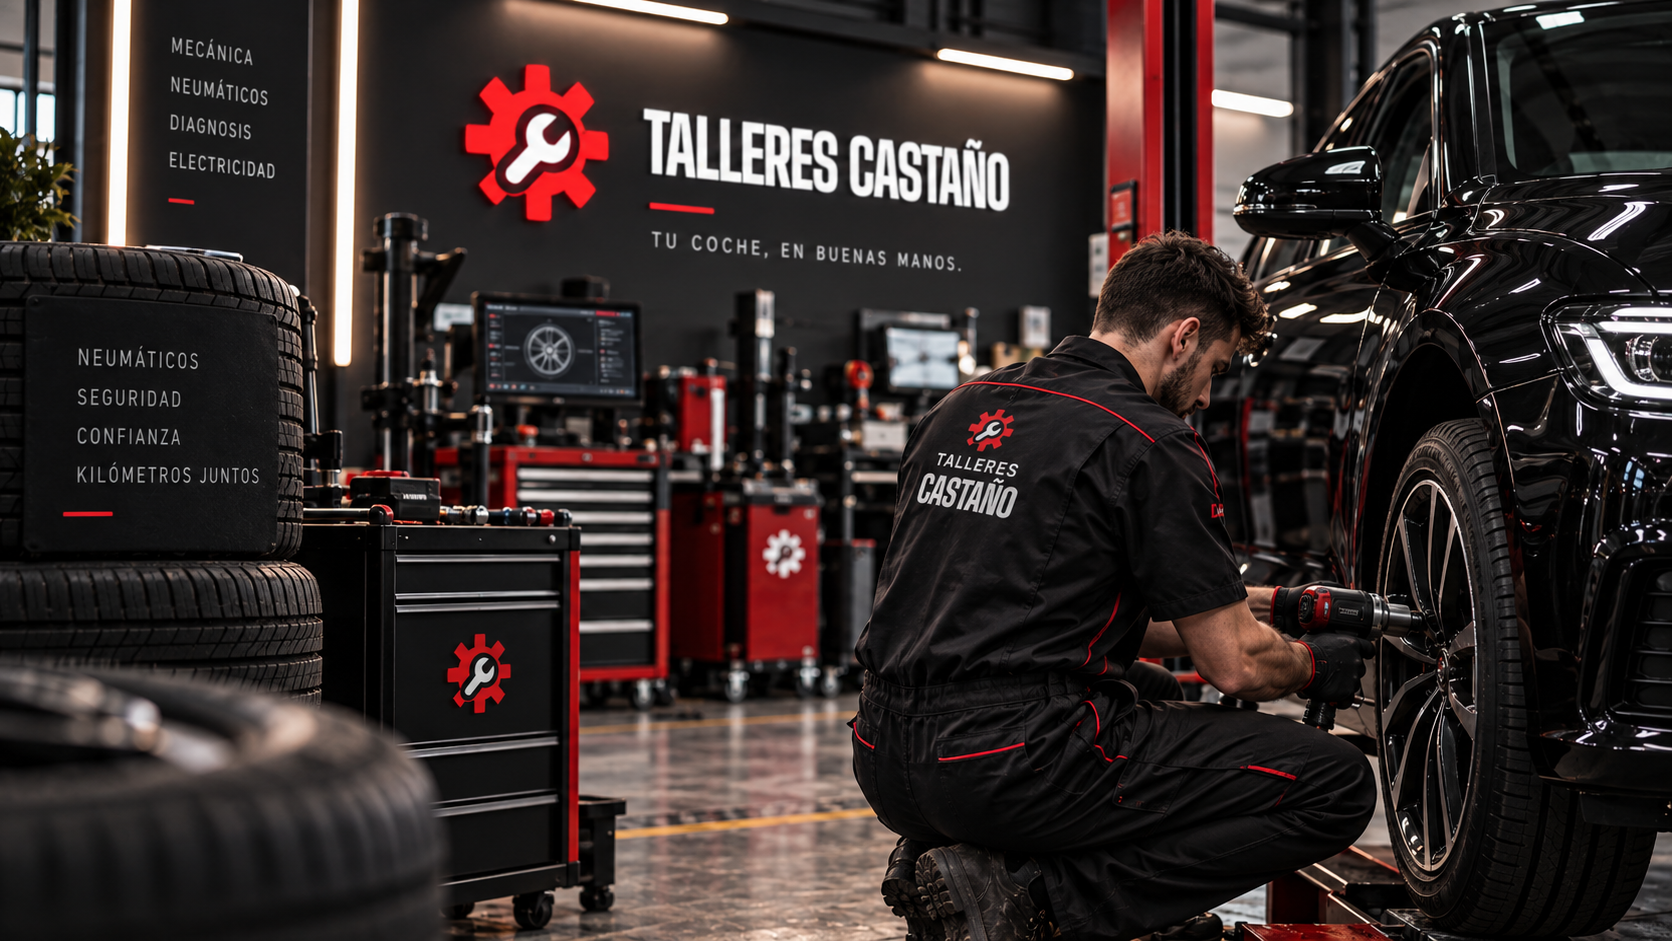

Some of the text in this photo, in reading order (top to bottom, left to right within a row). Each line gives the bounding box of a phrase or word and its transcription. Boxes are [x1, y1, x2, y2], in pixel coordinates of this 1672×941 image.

[171, 36, 253, 66] MECÁNICA
[170, 75, 268, 106] NEUMÁTICOS
[170, 113, 252, 140] DIAGNOSIS
[169, 151, 275, 179] ELECTRICIDAD
[643, 107, 1010, 212] TALLERES CASTAÑO
[651, 230, 962, 272] TU COCHE, EN BUENAS MANOS.
[78, 345, 199, 370] NEUMÁTICOS
[77, 388, 181, 408] SEGURIDAD
[77, 427, 181, 446] CONFIANZA
[77, 461, 260, 484] KILÓMETROS JUNTOS
[936, 452, 1019, 478] TALLERES
[916, 472, 1018, 519] CASTAÑO
